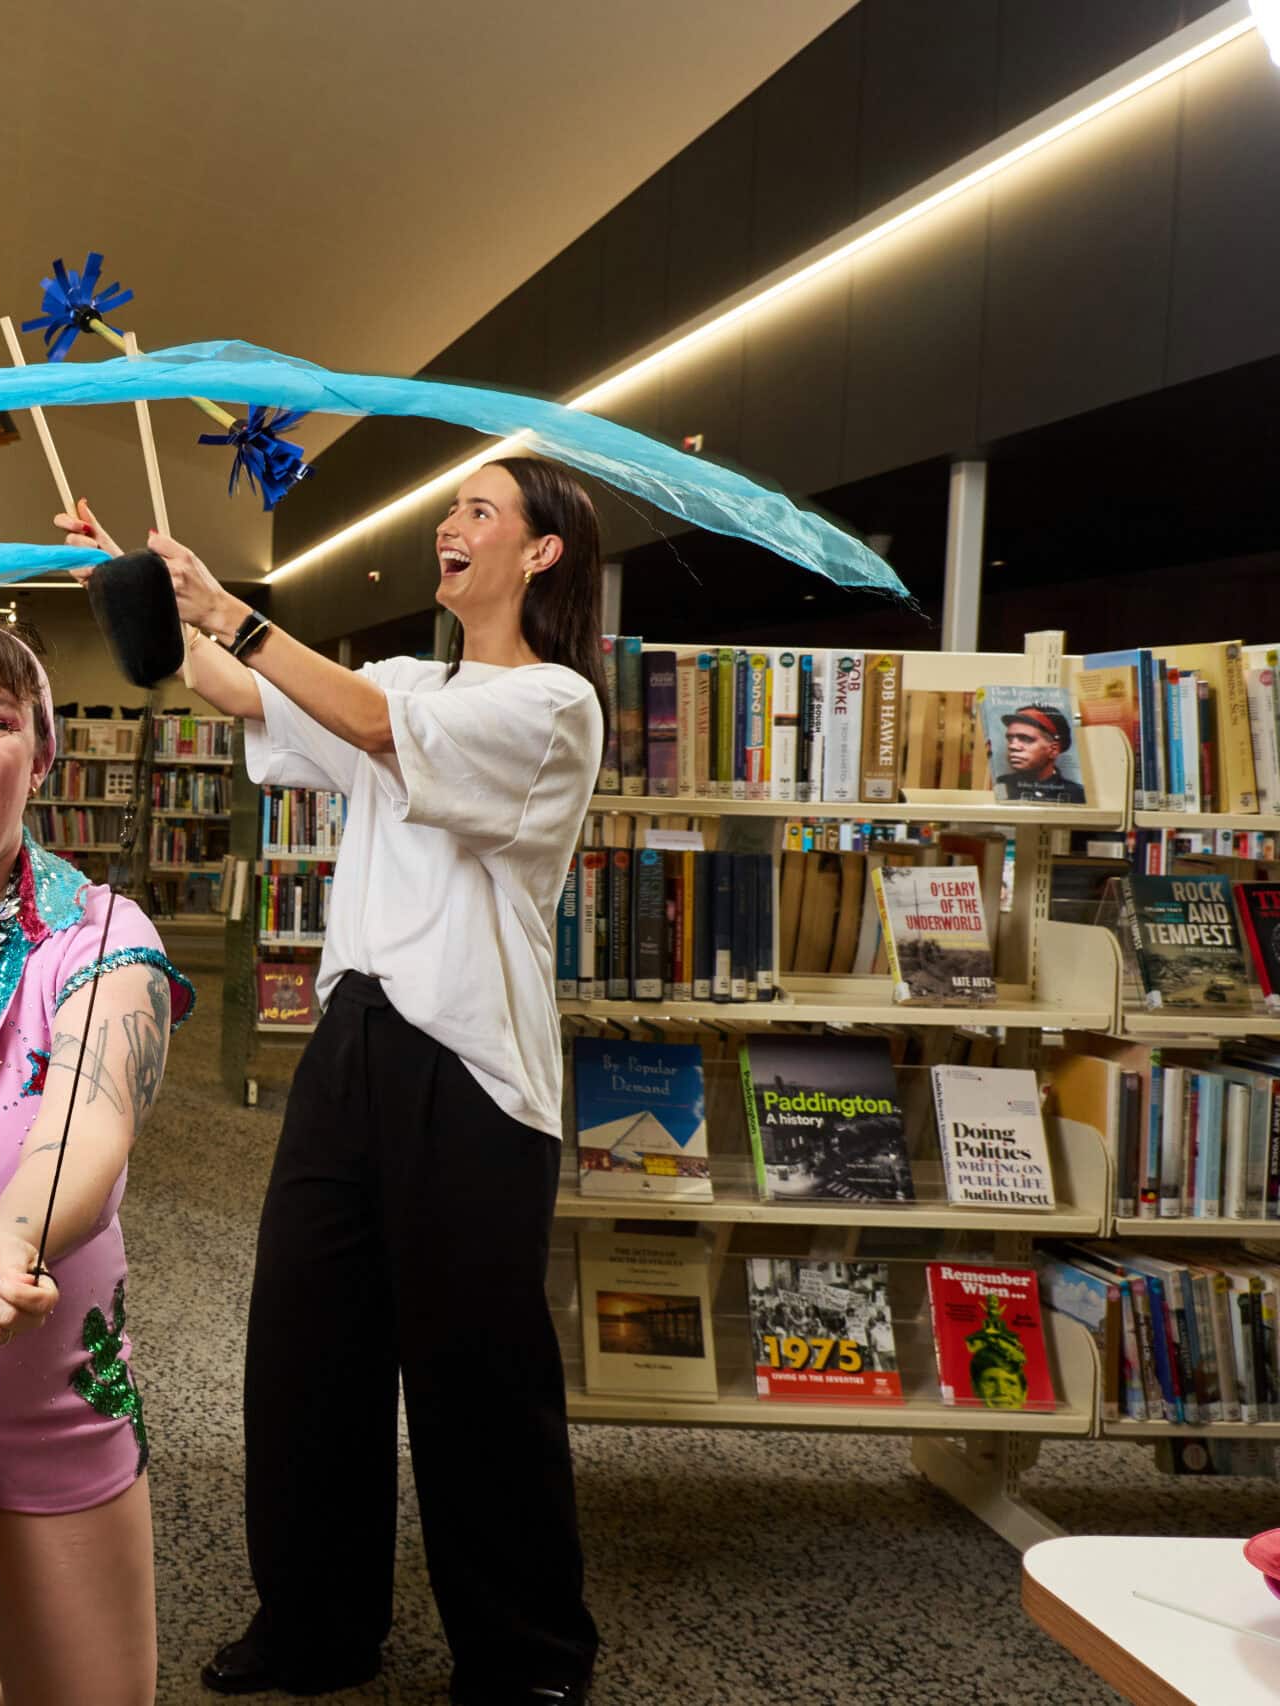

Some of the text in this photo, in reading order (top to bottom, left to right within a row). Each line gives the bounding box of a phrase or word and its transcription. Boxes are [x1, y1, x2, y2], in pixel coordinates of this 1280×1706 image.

[879, 705, 895, 766] HAWKE
[930, 881, 975, 897] O'LEARY
[1171, 881, 1225, 902] ROCK
[564, 893, 576, 917] RUDD
[940, 899, 979, 914] OF THE
[1188, 904, 1230, 923] AND
[906, 915, 982, 931] UNDERWORLD
[1144, 923, 1233, 946] TEMPEST
[602, 1054, 680, 1076] By Popular
[611, 1074, 671, 1096] Demand
[763, 1091, 893, 1118] Paddington
[766, 1113, 825, 1128] A history
[952, 1122, 1016, 1143] Doing
[955, 1142, 1032, 1160] Politics
[957, 1159, 1043, 1174] WRITING ON
[958, 1175, 1009, 1188] PUBLIC
[961, 1188, 1050, 1206] Judith Brett
[940, 1266, 1031, 1287] Remember
[960, 1281, 1027, 1299] When...
[762, 1335, 863, 1372] 1975
